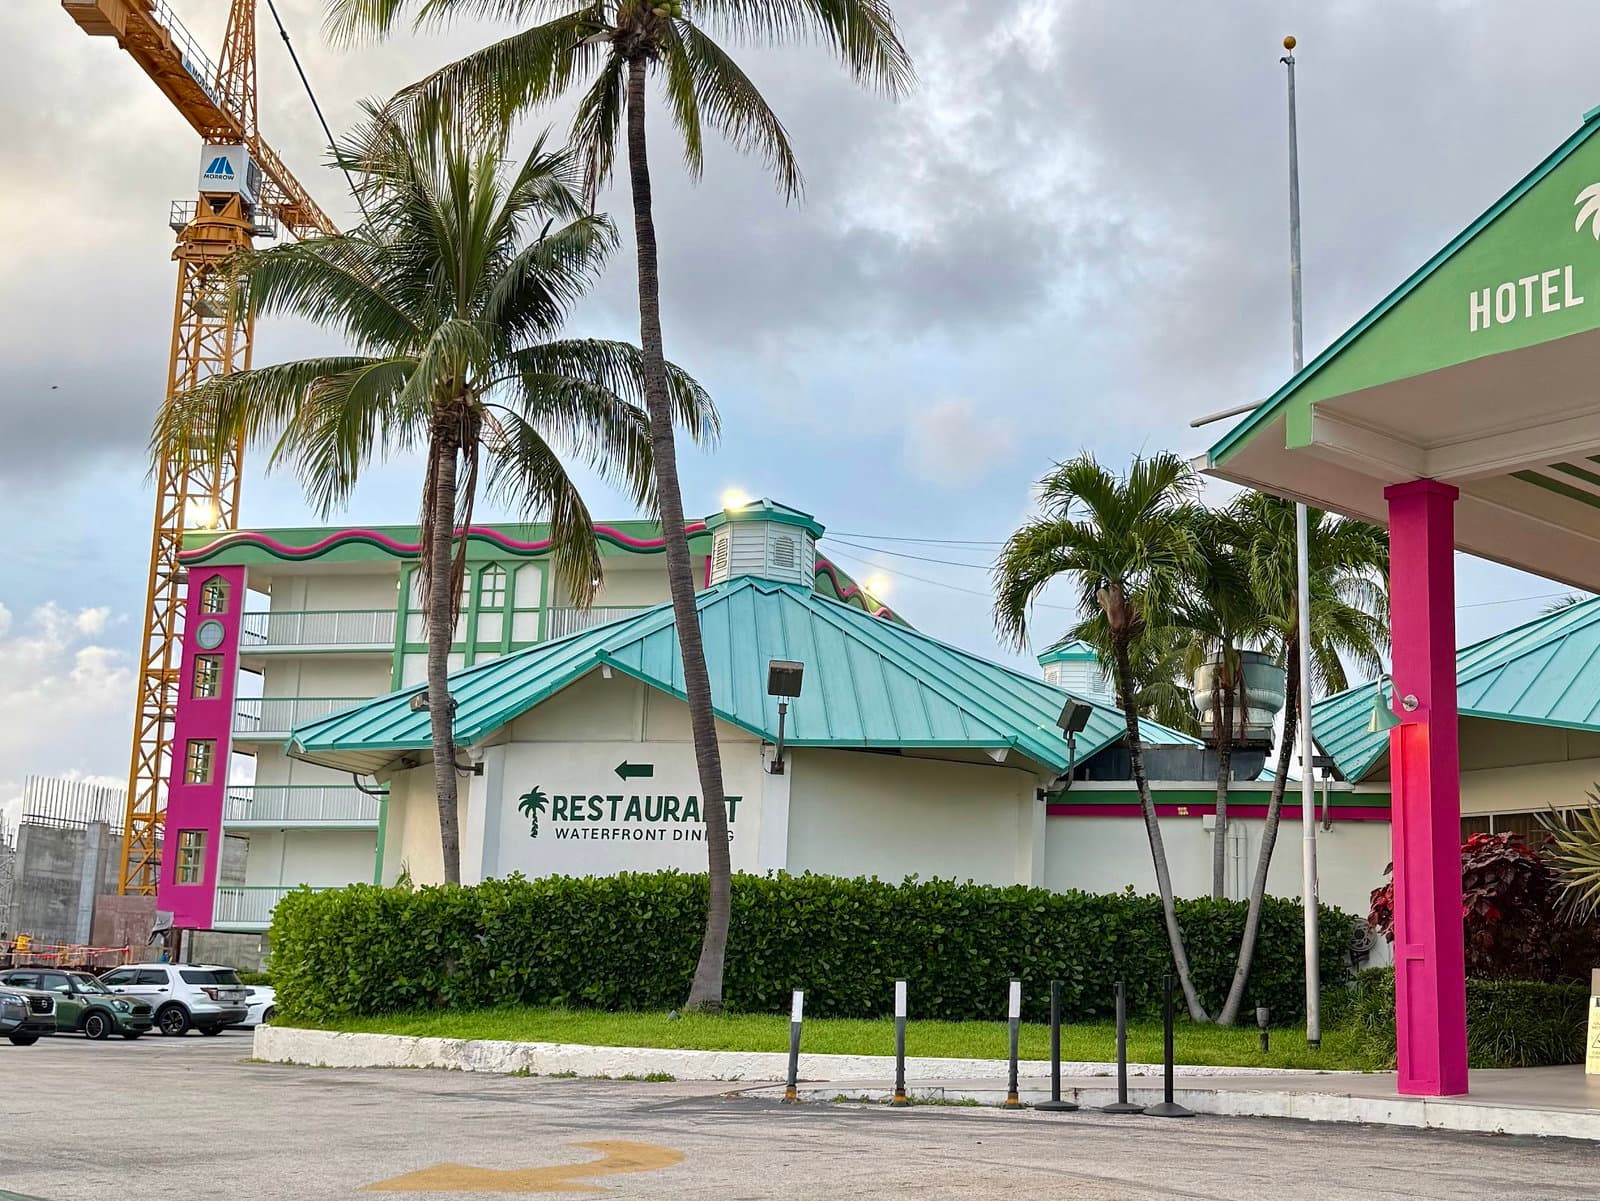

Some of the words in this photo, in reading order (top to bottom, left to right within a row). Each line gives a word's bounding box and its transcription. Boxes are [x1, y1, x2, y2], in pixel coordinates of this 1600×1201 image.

[1470, 265, 1584, 332] HOTEL
[552, 795, 742, 822] RESTAURAT
[555, 828, 667, 841] WATERFRONT
[672, 829, 734, 841] DINIG
